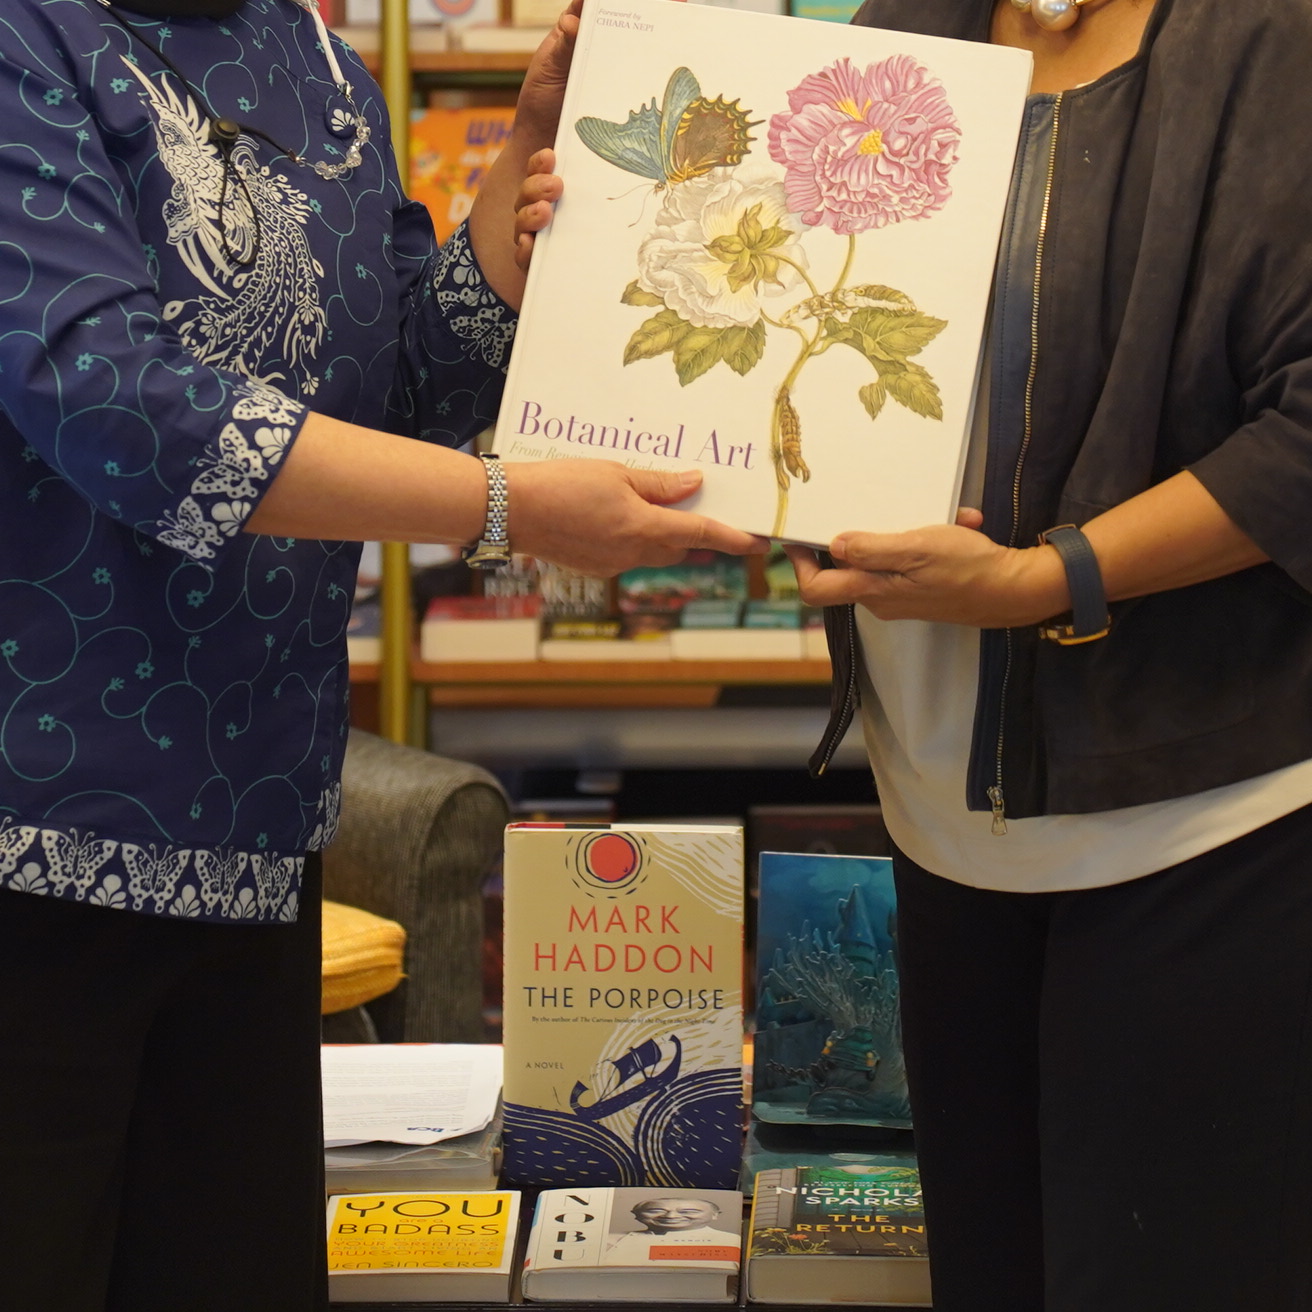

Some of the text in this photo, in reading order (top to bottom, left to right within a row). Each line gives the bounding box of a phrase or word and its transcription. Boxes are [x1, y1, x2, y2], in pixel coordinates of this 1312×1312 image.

[598, 7, 633, 19] Foreword
[596, 17, 655, 32] CHIARA NEPI
[514, 400, 758, 471] Botanical Art
[508, 440, 541, 458] From
[567, 904, 681, 934] MARK
[534, 942, 714, 974] HADDON
[522, 986, 725, 1010] THE PORPOISE
[525, 1061, 565, 1070] A NOVEL
[805, 1196, 919, 1206] SPARKS
[346, 1199, 503, 1218] YOU
[827, 1214, 890, 1223] THE
[338, 1224, 500, 1236] BADASS
[795, 1223, 925, 1234] RETURN
[329, 1262, 372, 1270] JEN
